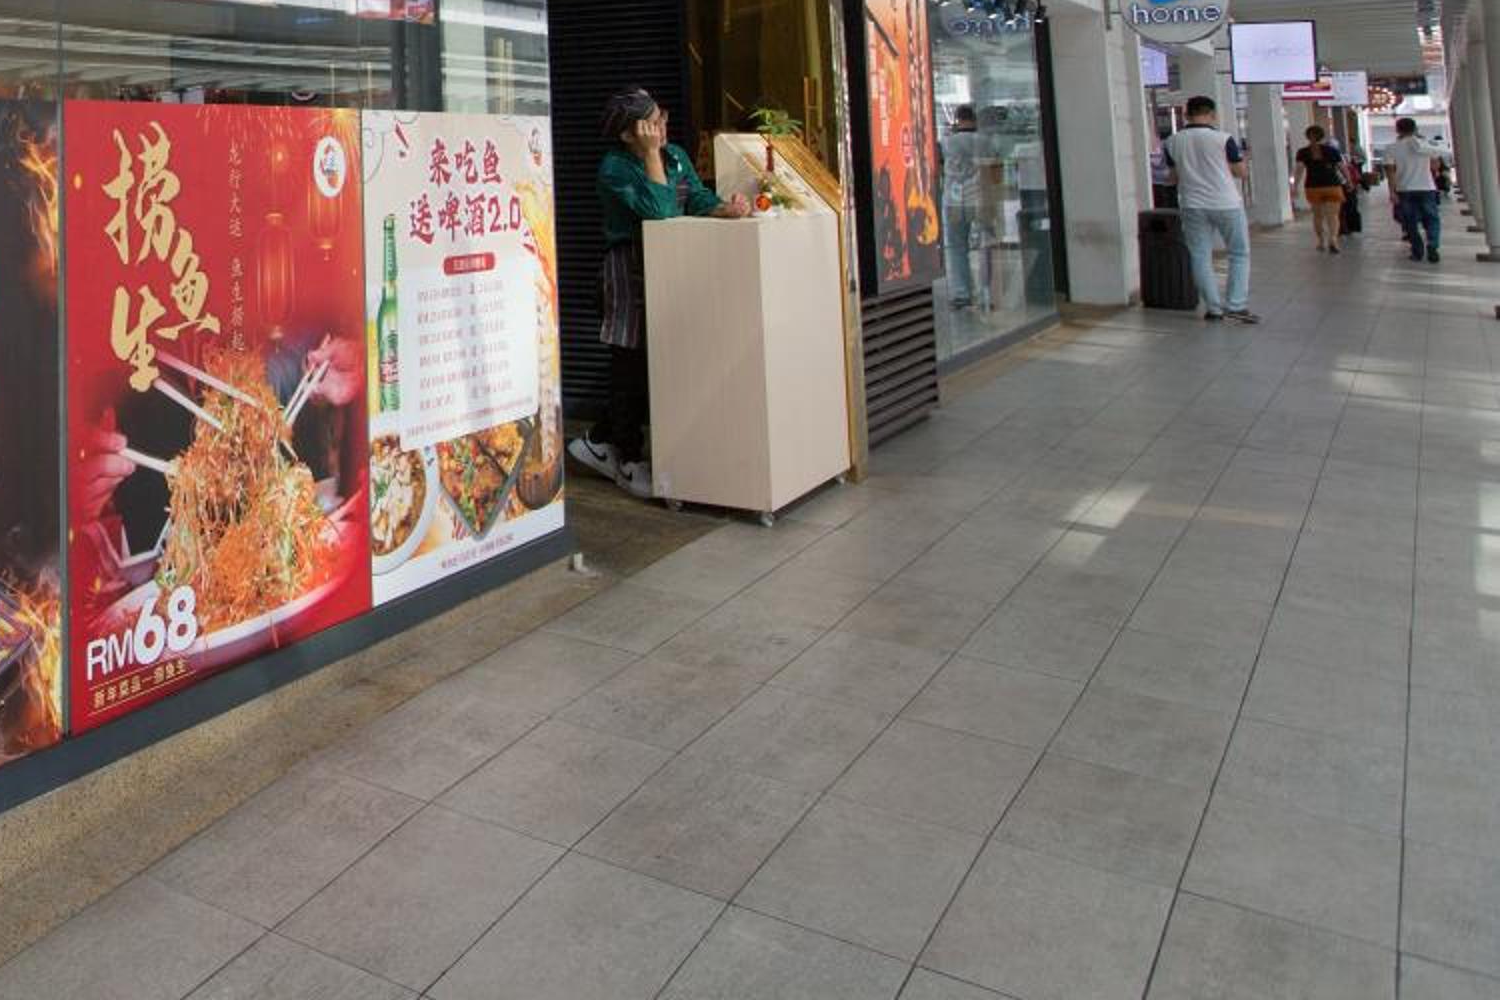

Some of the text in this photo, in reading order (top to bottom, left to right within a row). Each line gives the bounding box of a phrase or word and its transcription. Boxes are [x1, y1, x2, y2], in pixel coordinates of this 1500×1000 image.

[1131, 3, 1221, 24] home
[429, 138, 502, 187] 来吃鱼
[409, 191, 521, 245] 送啤酒2.0
[86, 584, 198, 681] RM68
